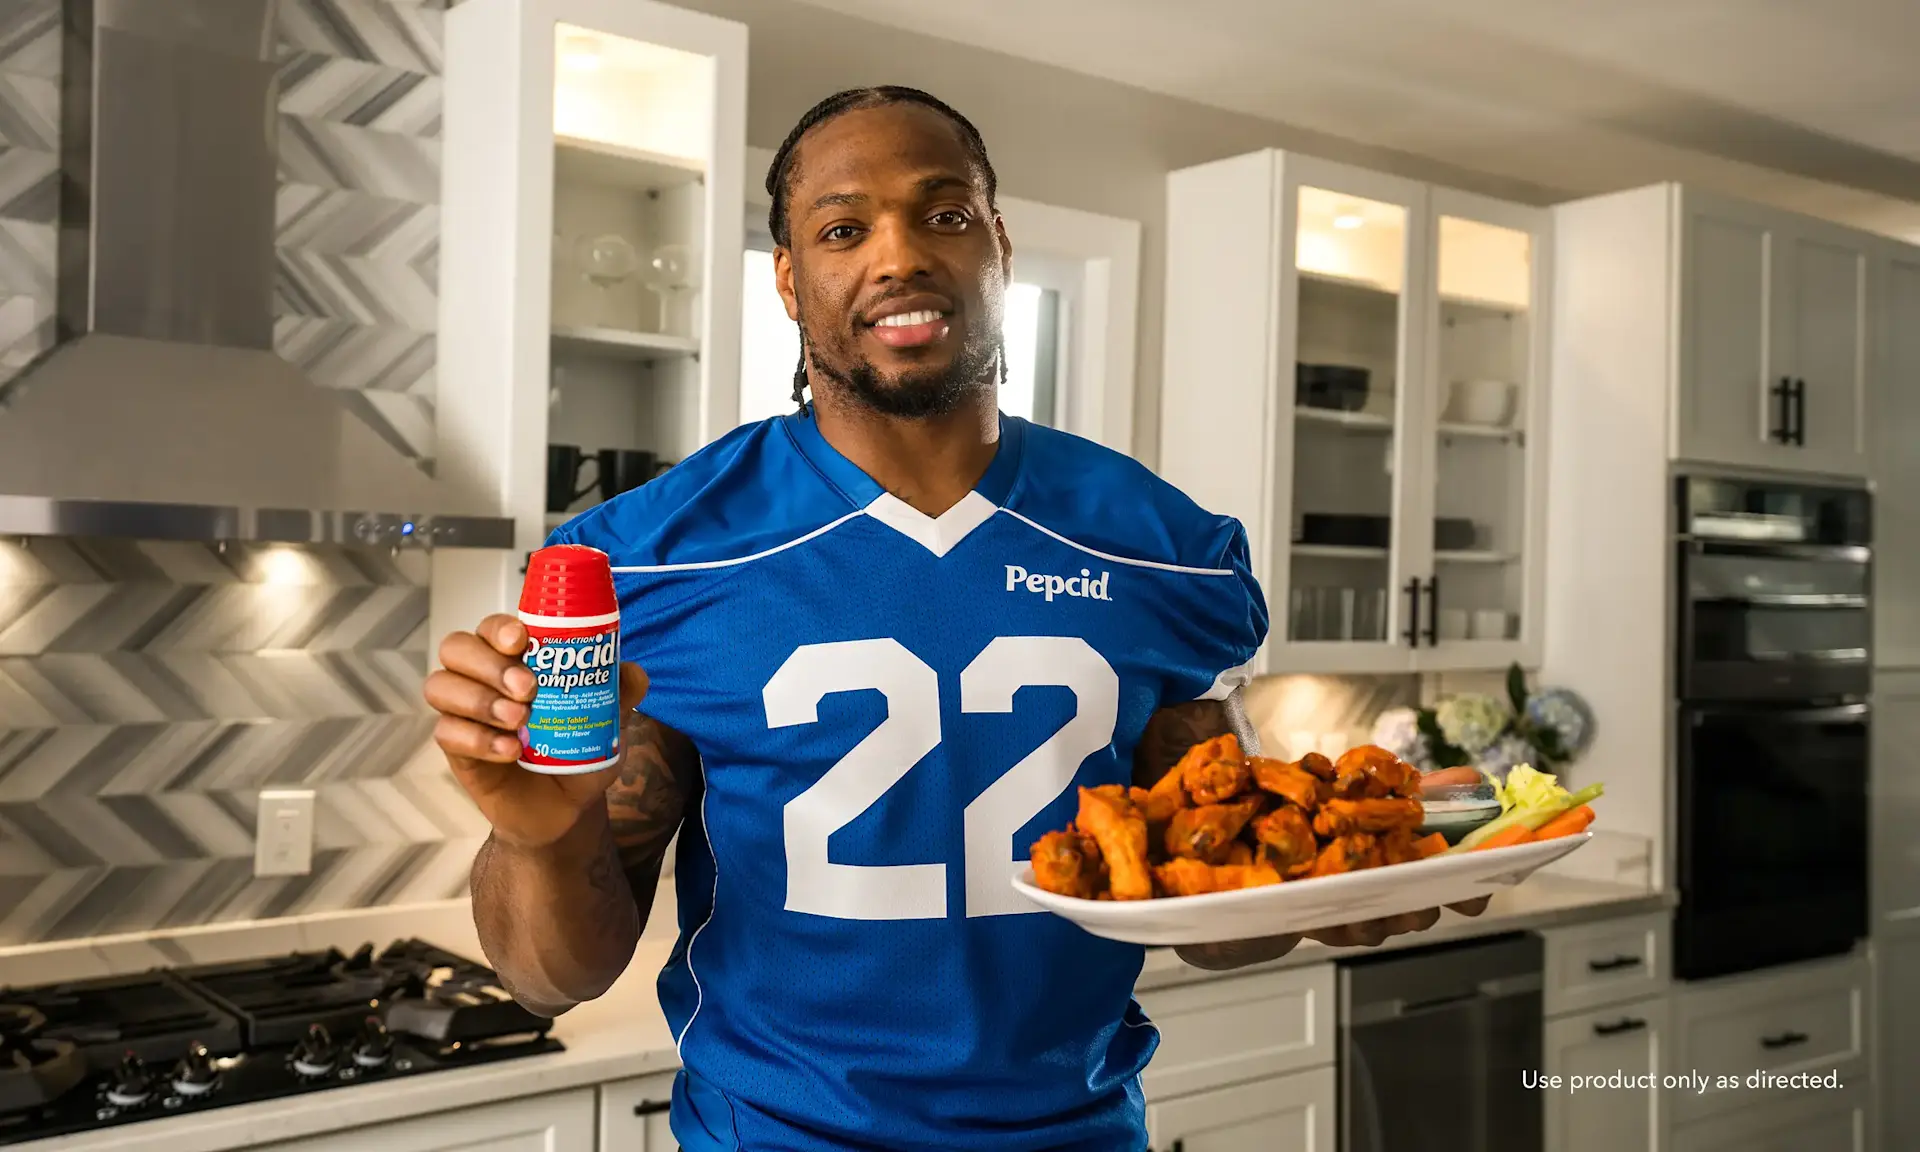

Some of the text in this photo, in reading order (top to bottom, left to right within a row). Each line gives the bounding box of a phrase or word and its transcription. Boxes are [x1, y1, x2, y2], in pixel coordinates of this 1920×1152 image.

[564, 635, 595, 644] ACTION
[522, 632, 616, 676] Pepcid
[531, 667, 609, 693] omplete
[539, 715, 589, 724] Just One Tablet!
[533, 743, 549, 757] 50
[581, 745, 601, 753] Tablets
[762, 636, 1119, 920] 22
